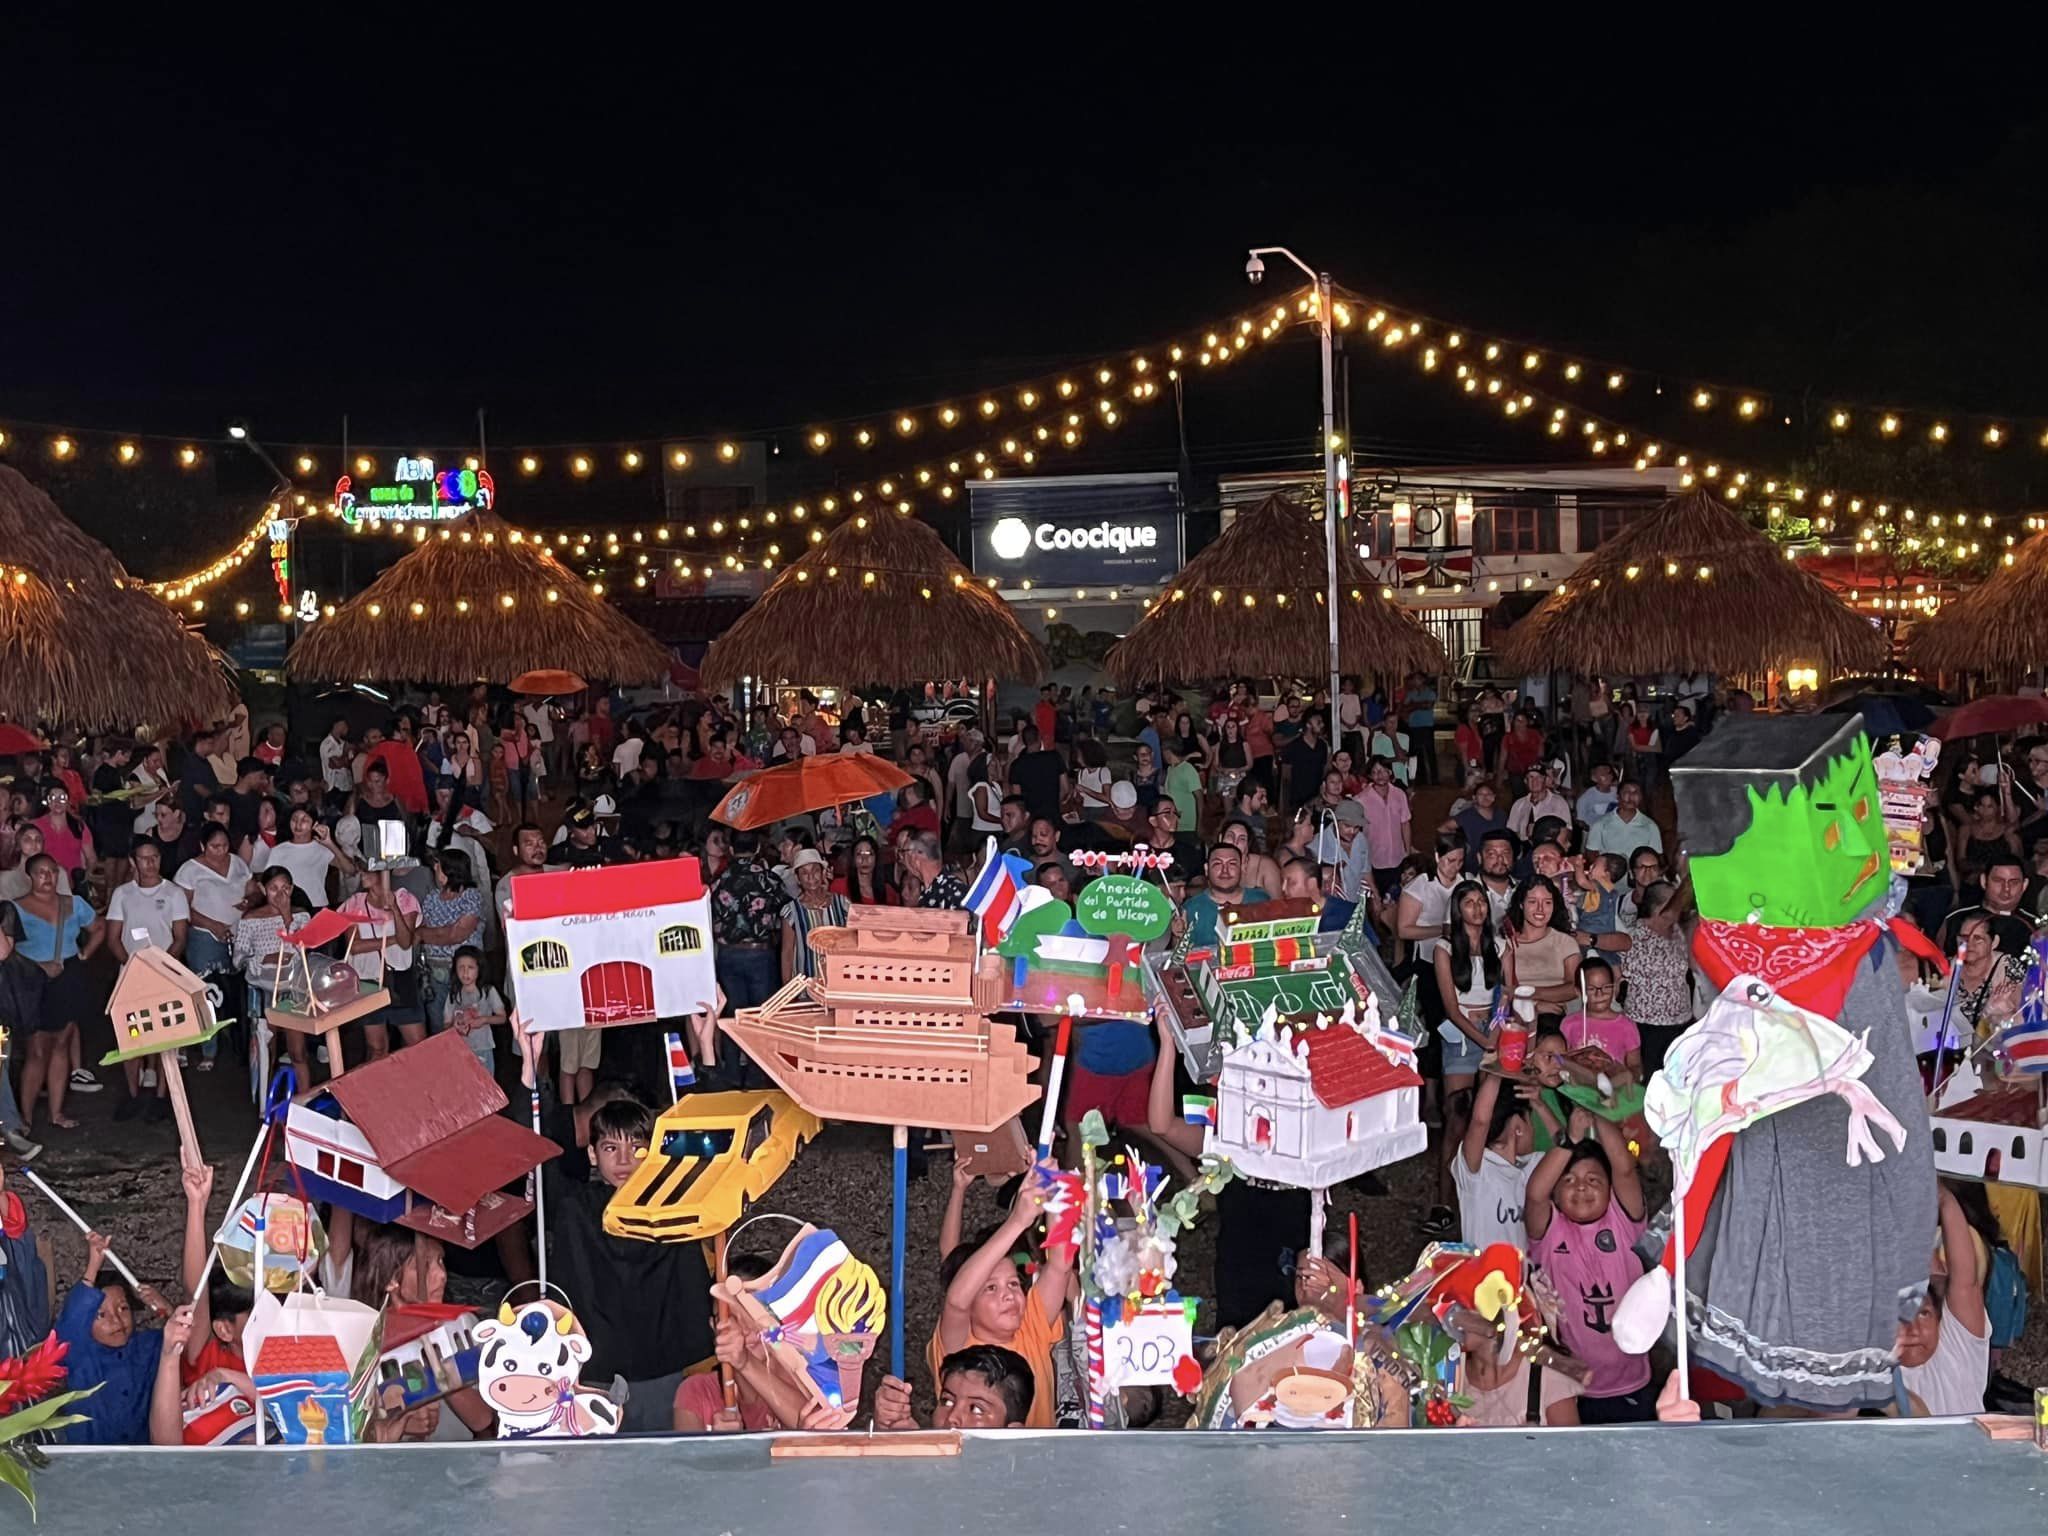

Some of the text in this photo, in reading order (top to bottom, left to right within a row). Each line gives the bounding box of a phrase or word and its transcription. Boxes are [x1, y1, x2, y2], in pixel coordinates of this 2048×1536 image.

[1035, 521, 1157, 554] Coocique
[1071, 849, 1107, 867] 200
[1095, 881, 1148, 895] Anexión
[1084, 895, 1150, 908] del Partido
[1092, 909, 1158, 926] de Nicoya
[1116, 1335, 1176, 1374] 203
